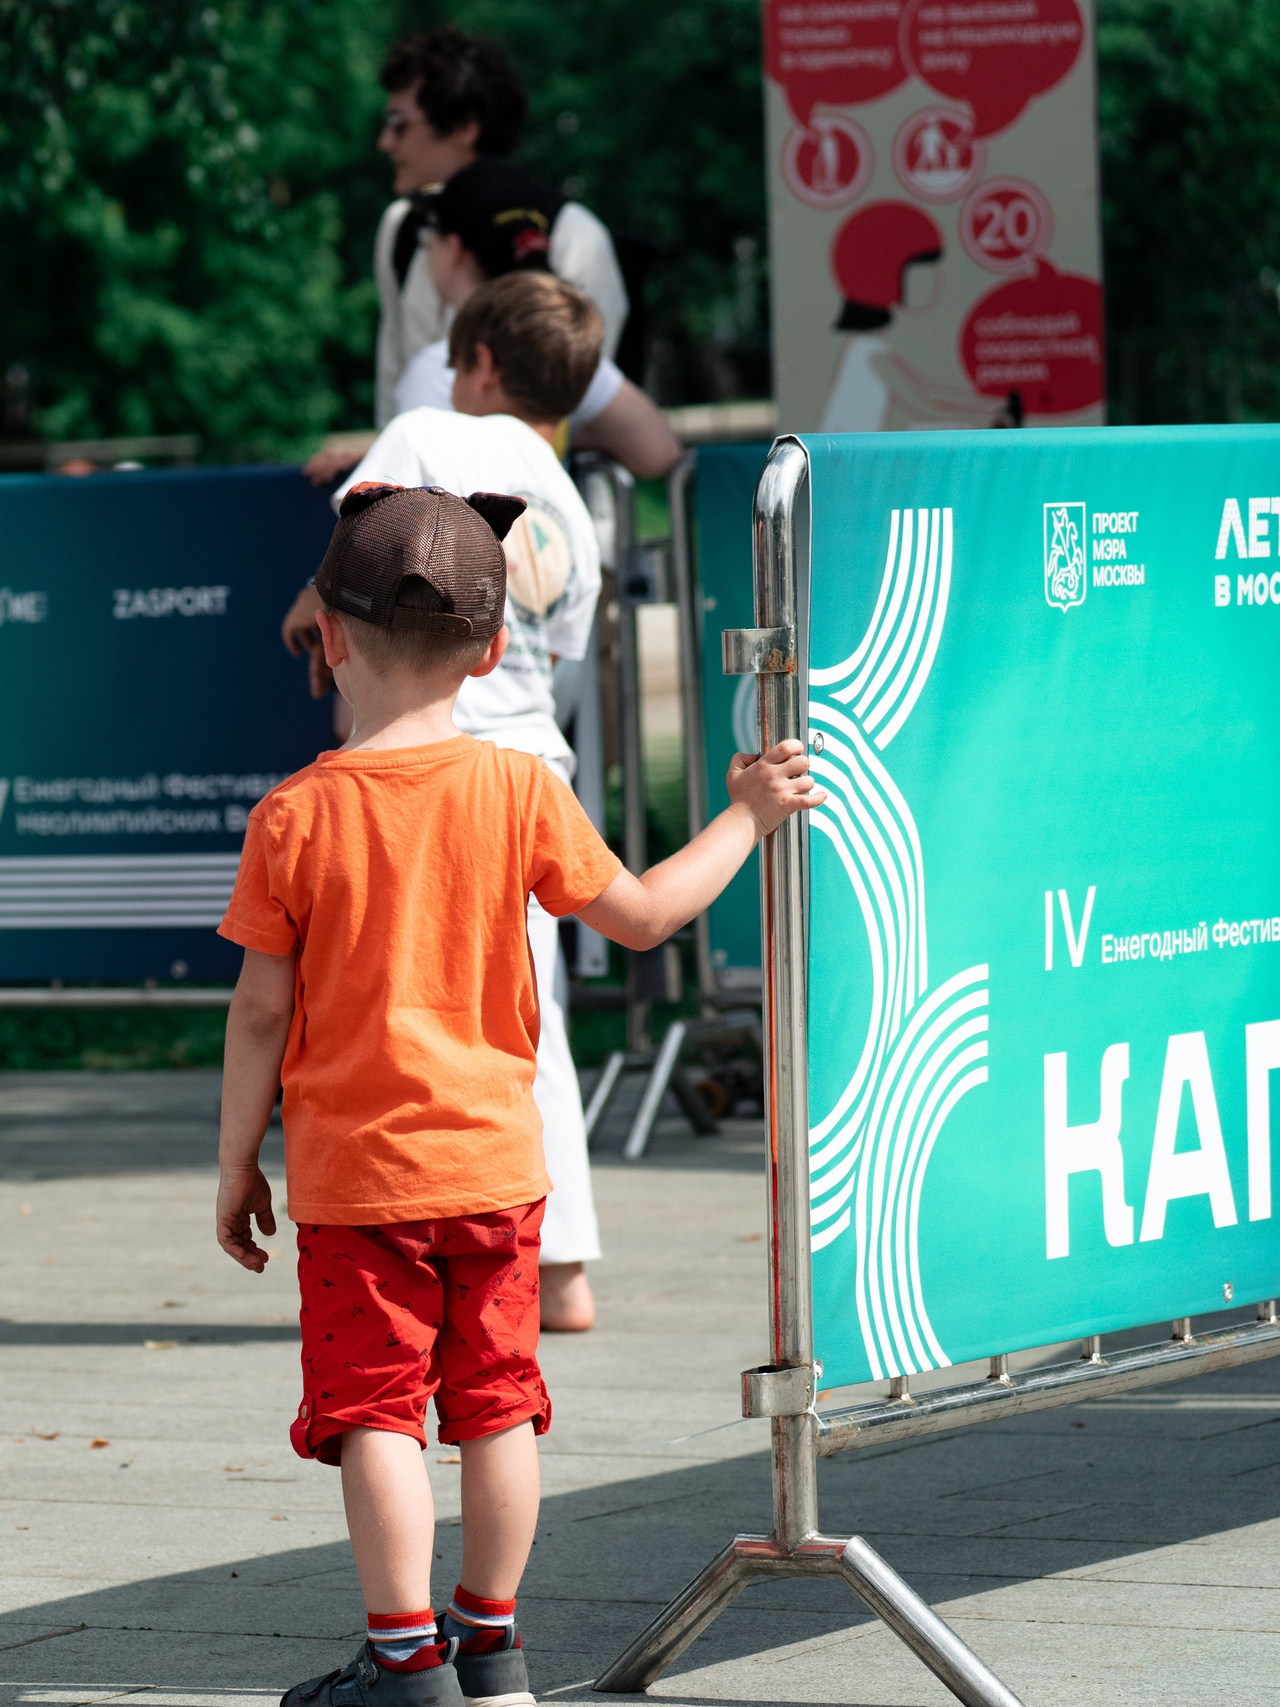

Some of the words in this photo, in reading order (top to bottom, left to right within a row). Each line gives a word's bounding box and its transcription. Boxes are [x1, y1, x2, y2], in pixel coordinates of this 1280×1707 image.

[974, 200, 1037, 251] 20
[1092, 512, 1139, 534] ПРОЕКТ
[1092, 539, 1127, 561] МЭРА
[1092, 564, 1145, 587] МОСКВЫ
[1214, 574, 1231, 607] В
[1237, 571, 1280, 606] МОС
[114, 586, 229, 619] ZASPORT
[1045, 886, 1096, 971] IV
[1101, 921, 1208, 964] Ежегодный
[1212, 917, 1280, 949] Фестив
